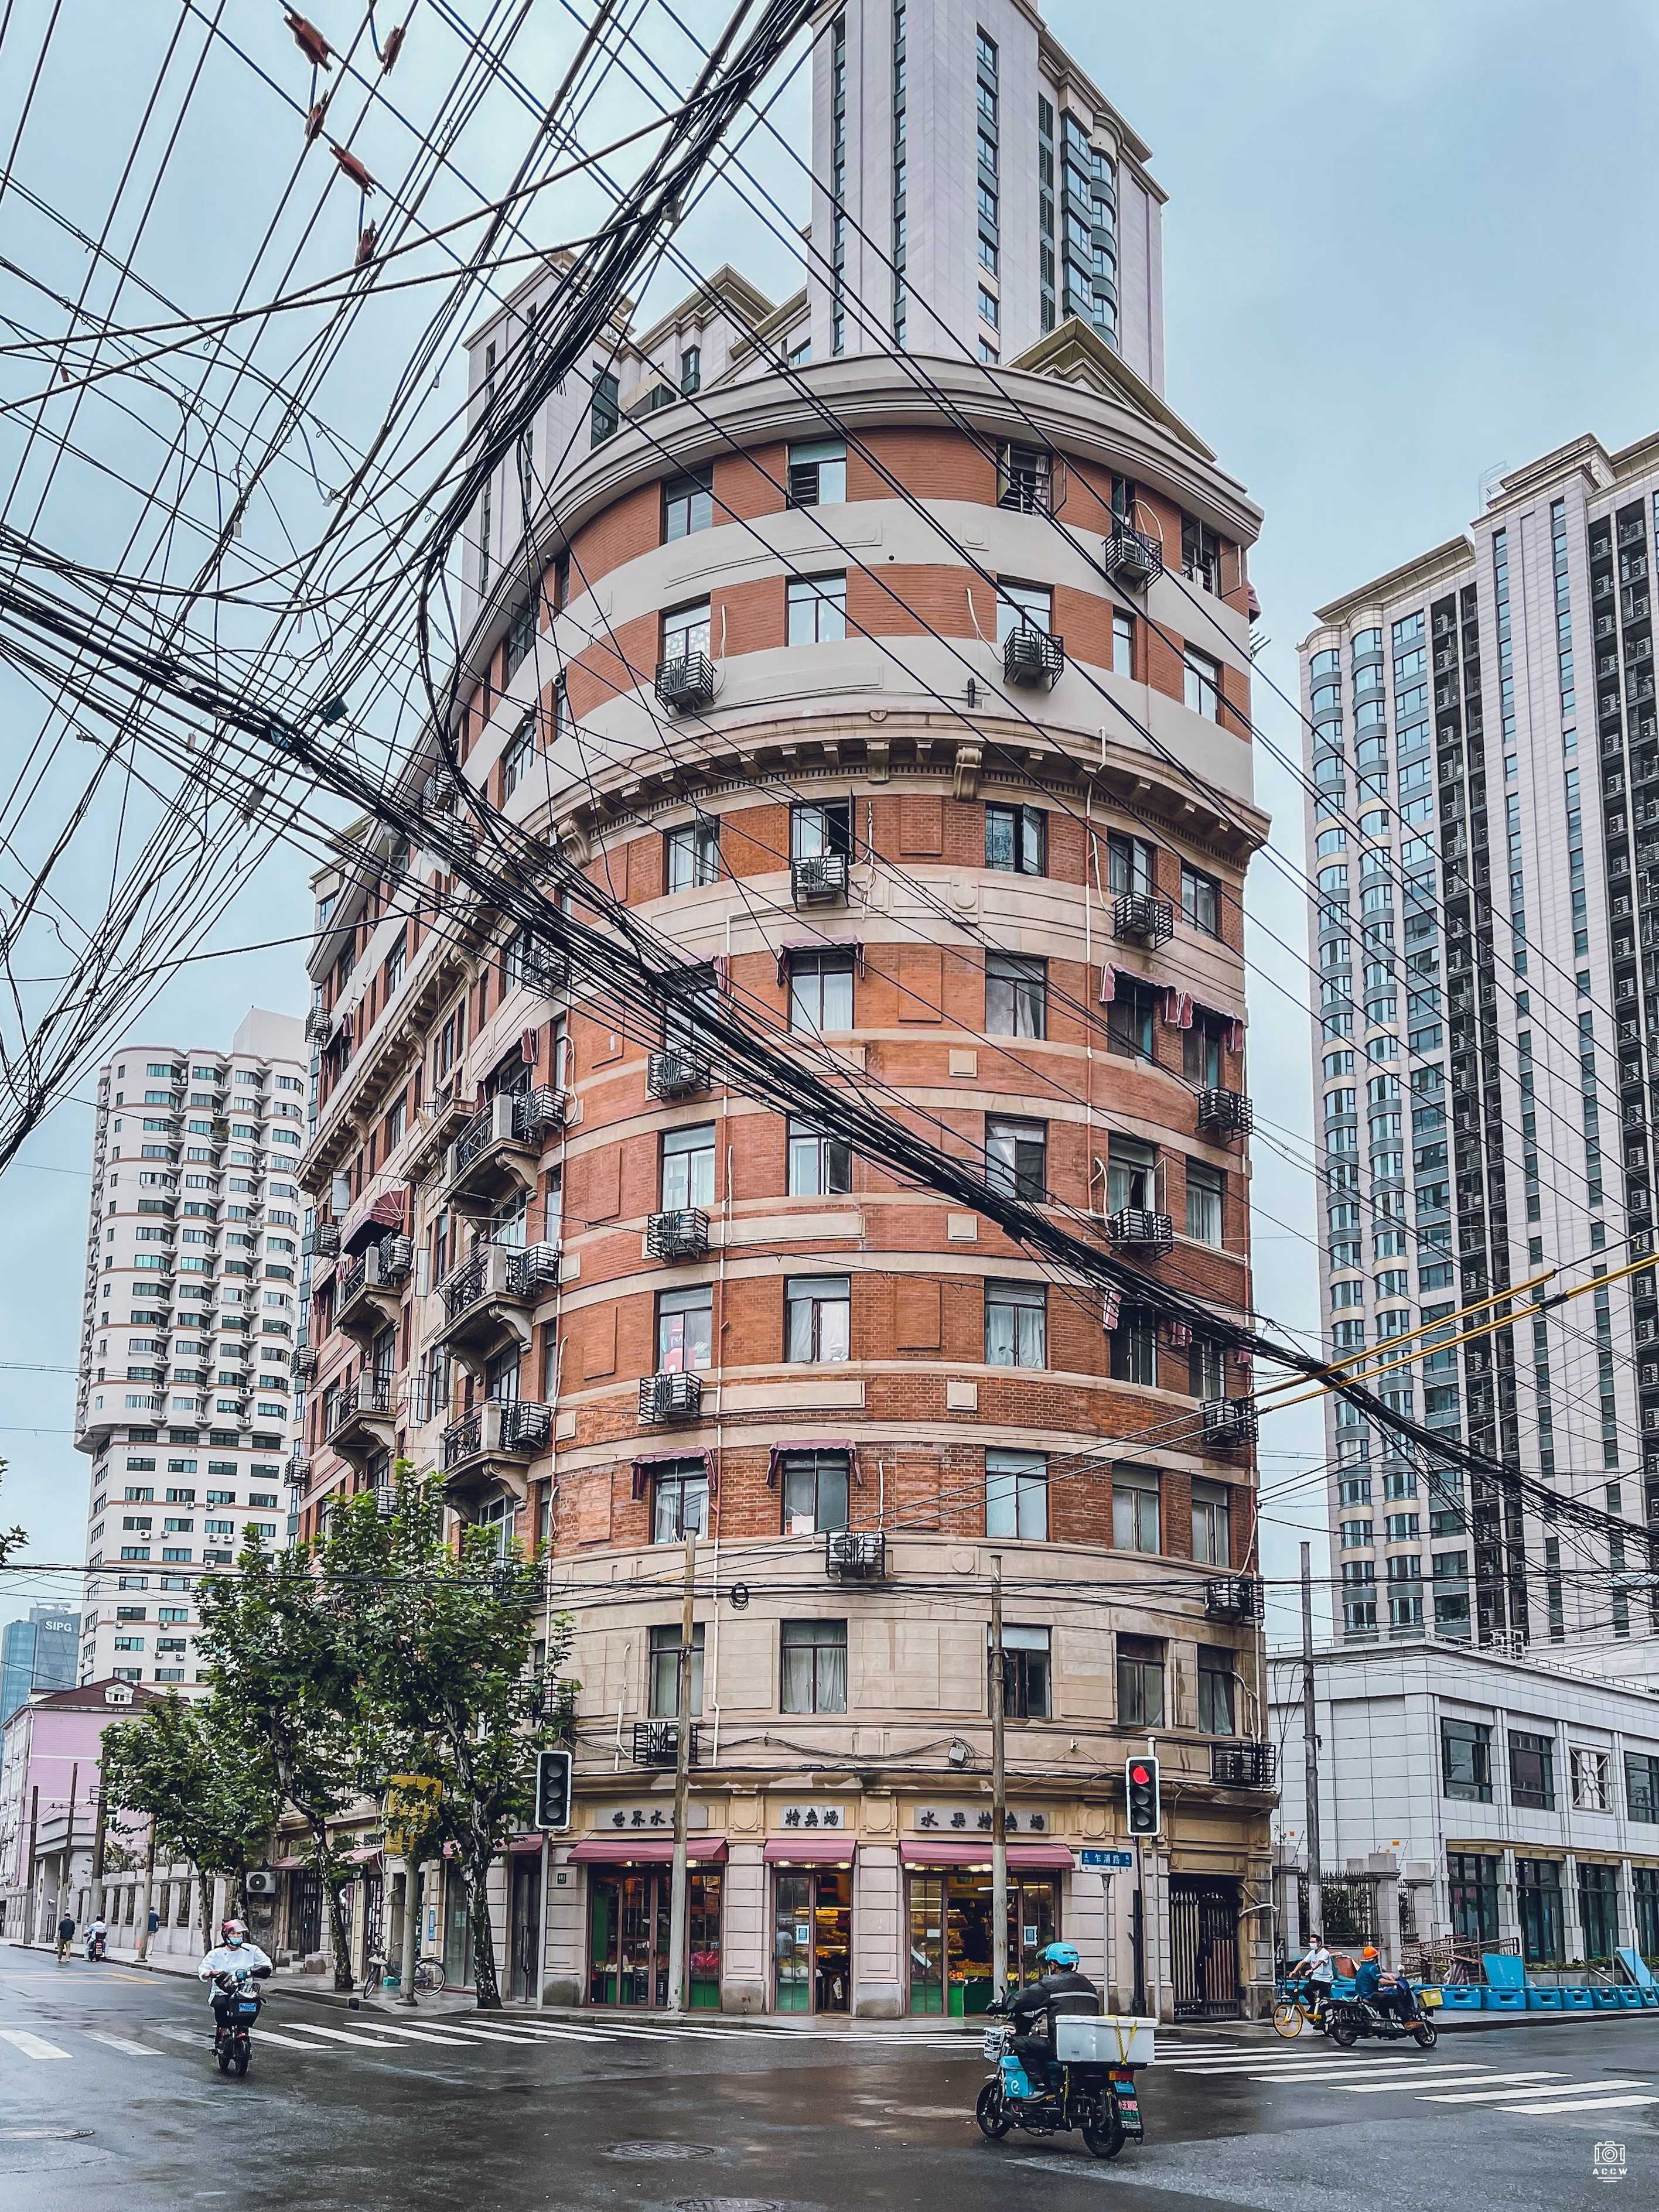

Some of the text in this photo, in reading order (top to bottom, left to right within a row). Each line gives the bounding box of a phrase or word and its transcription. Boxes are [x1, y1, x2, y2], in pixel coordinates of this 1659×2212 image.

[45, 1620, 72, 1632] SIPG
[785, 1808, 839, 1827] 特卖场
[920, 1810, 1045, 1831] 水果特卖场
